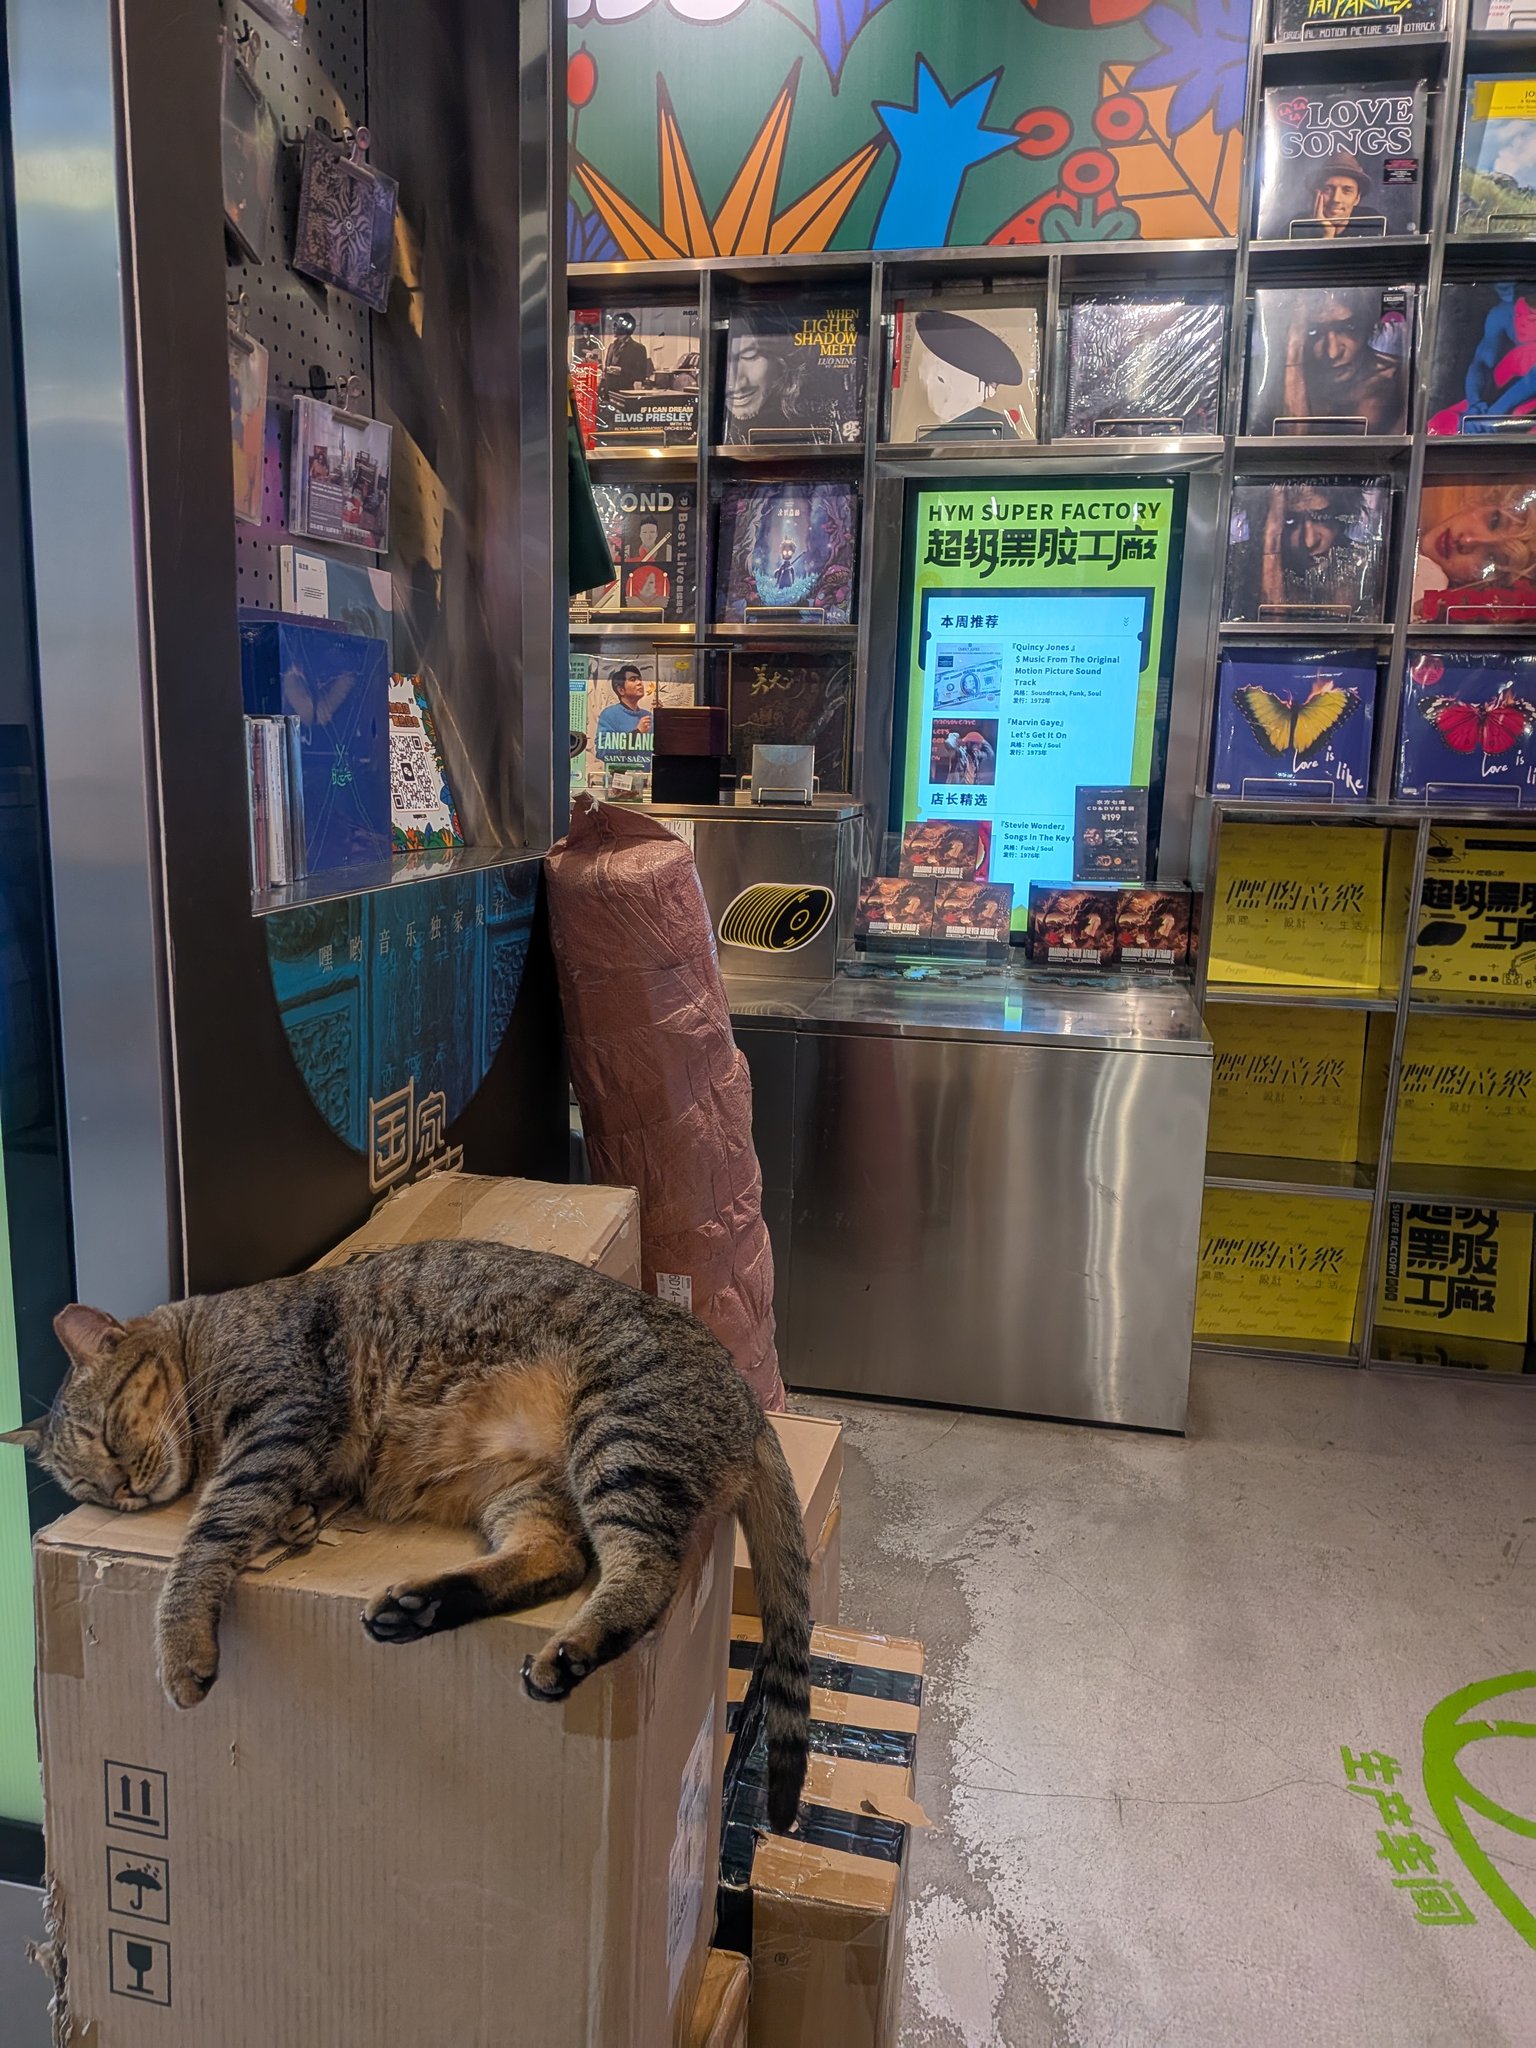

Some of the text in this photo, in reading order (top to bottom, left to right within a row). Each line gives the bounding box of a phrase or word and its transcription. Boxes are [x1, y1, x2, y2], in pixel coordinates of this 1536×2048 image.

[1350, 25, 1382, 36] PICTURE
[1525, 90, 1536, 98] JO
[1306, 97, 1413, 128] LOVE
[1280, 126, 1412, 158] SONGS
[826, 309, 859, 319] WHEN
[794, 331, 858, 346] SHADOW
[820, 344, 856, 356] MEET
[835, 357, 857, 365] NING
[614, 413, 693, 423] ELVIS PRESLEY
[621, 492, 674, 513] OND
[929, 501, 1161, 522] HYM SUPER FACTORY
[940, 614, 999, 629] 本周推荐
[1022, 656, 1045, 664] Music
[1047, 656, 1068, 664] From
[1070, 656, 1085, 664] The
[1087, 656, 1120, 665] Original
[1015, 667, 1102, 675] Motion Picture Sound
[1014, 678, 1037, 686] Track
[598, 731, 627, 750] LANG
[1011, 731, 1030, 739] Let's
[1325, 745, 1335, 762] is
[1336, 761, 1364, 795] like
[1516, 750, 1525, 766] is
[1526, 766, 1536, 785] li
[931, 792, 988, 806] 店长精选
[1101, 813, 1121, 821] ¥199
[1004, 833, 1028, 842] Songs
[1055, 834, 1070, 843] Key
[318, 897, 505, 974] 嘿哟音乐独家发行
[1391, 1203, 1400, 1234] SUPER
[1388, 1235, 1399, 1276] FACTORY
[1339, 1743, 1479, 1926] 生产车间
